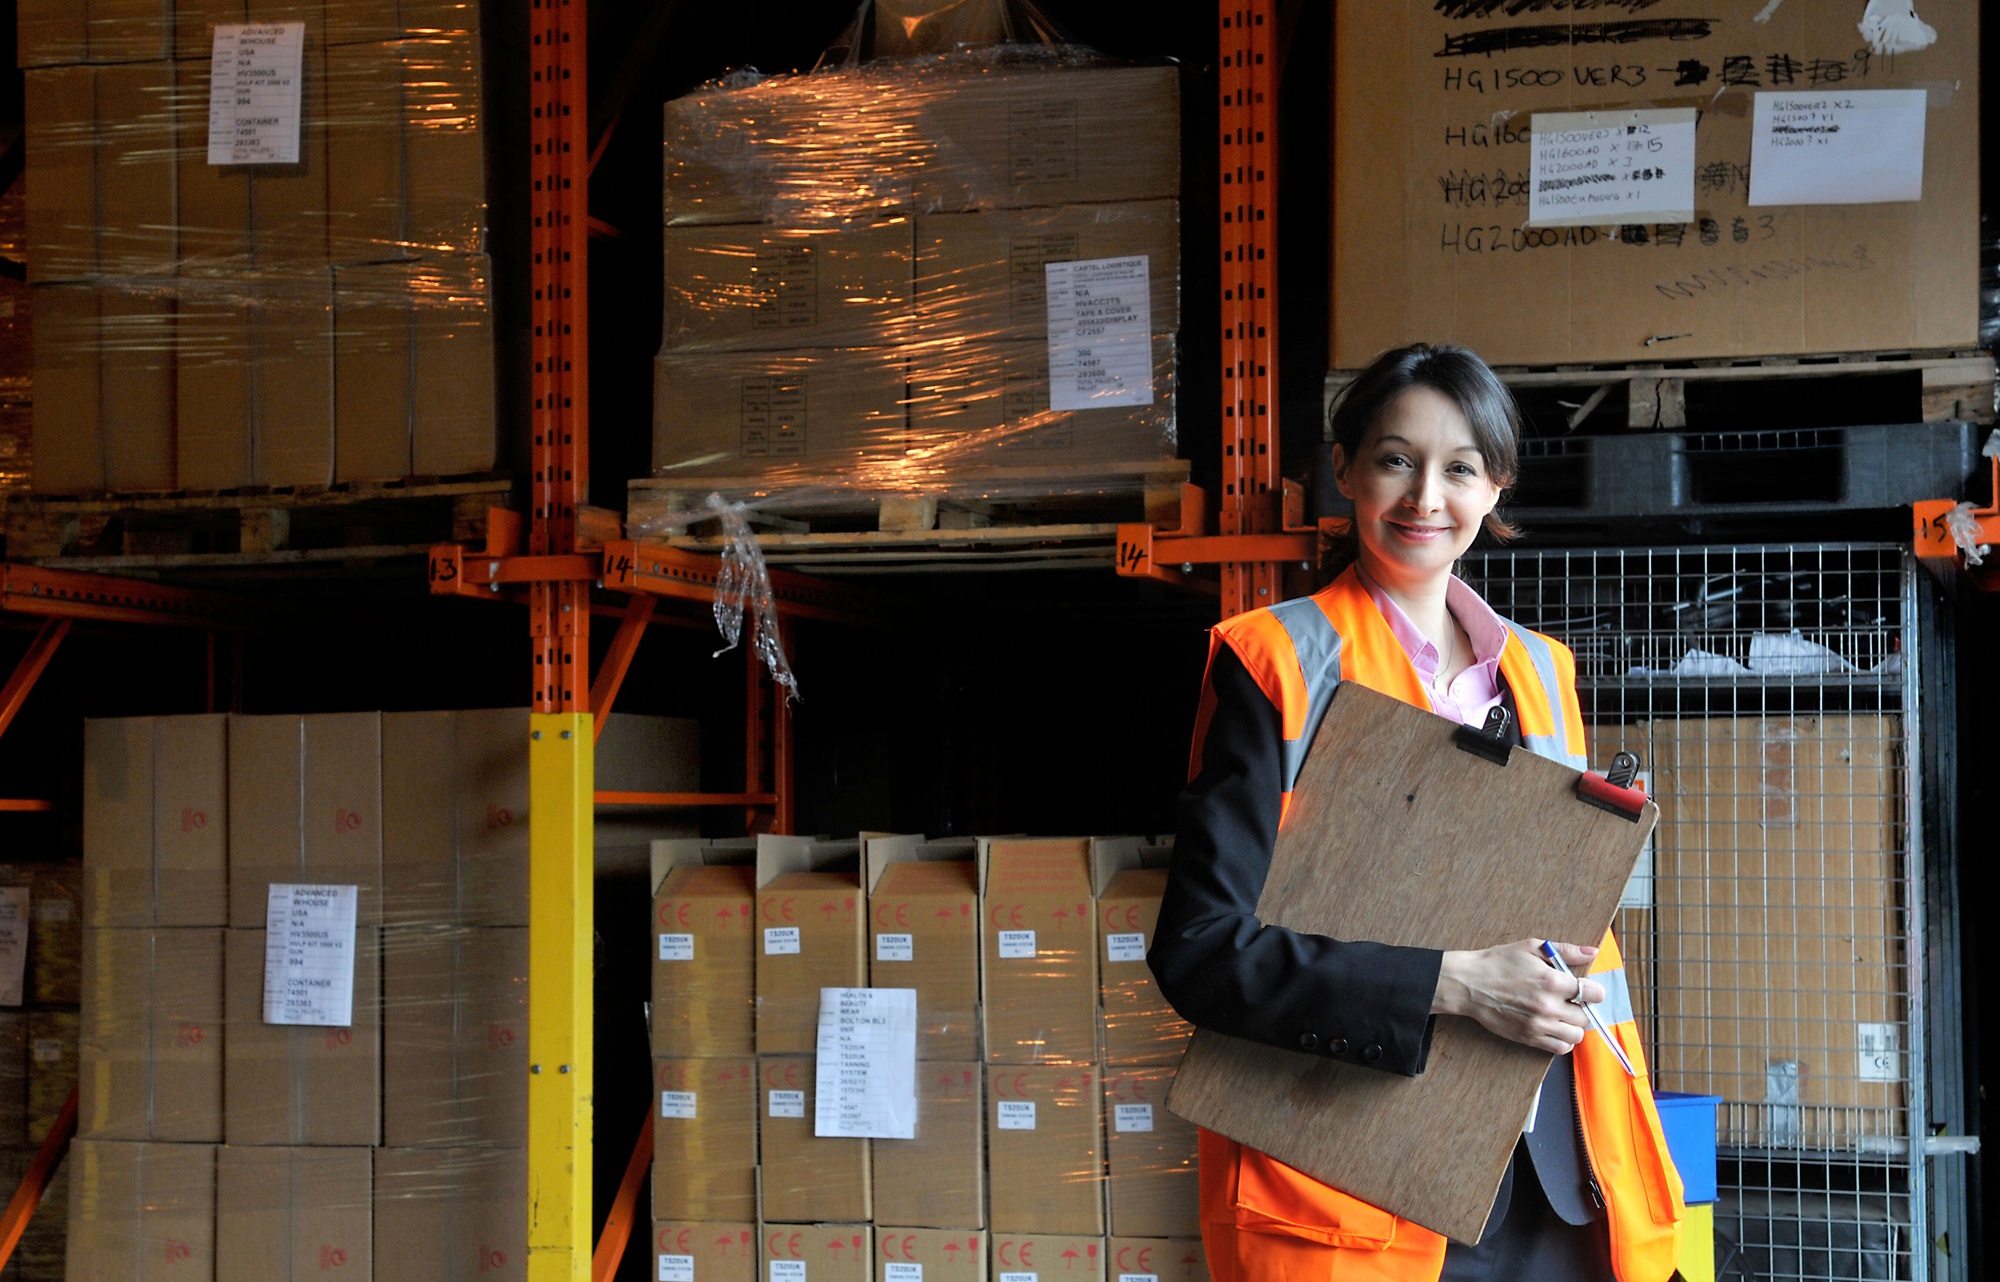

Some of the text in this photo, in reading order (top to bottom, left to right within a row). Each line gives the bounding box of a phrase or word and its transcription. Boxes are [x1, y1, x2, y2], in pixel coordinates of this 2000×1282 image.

[241, 27, 285, 36] ADVANCED
[239, 48, 255, 56] USA
[1572, 65, 1648, 89] VER3
[235, 117, 279, 126] CONTAINER
[1073, 260, 1142, 272] CARTEL LOGISTIQUE
[1076, 308, 1095, 317] TAPE
[1104, 306, 1132, 315] COVER
[1922, 512, 1948, 543] 15
[1121, 541, 1148, 573] 14
[430, 557, 458, 582] 13
[605, 554, 634, 583] 14
[294, 888, 338, 897] ADVANCED
[769, 929, 794, 937] TS20UK
[287, 979, 331, 988] CONTAINER
[774, 1092, 799, 1100] TS20UK
